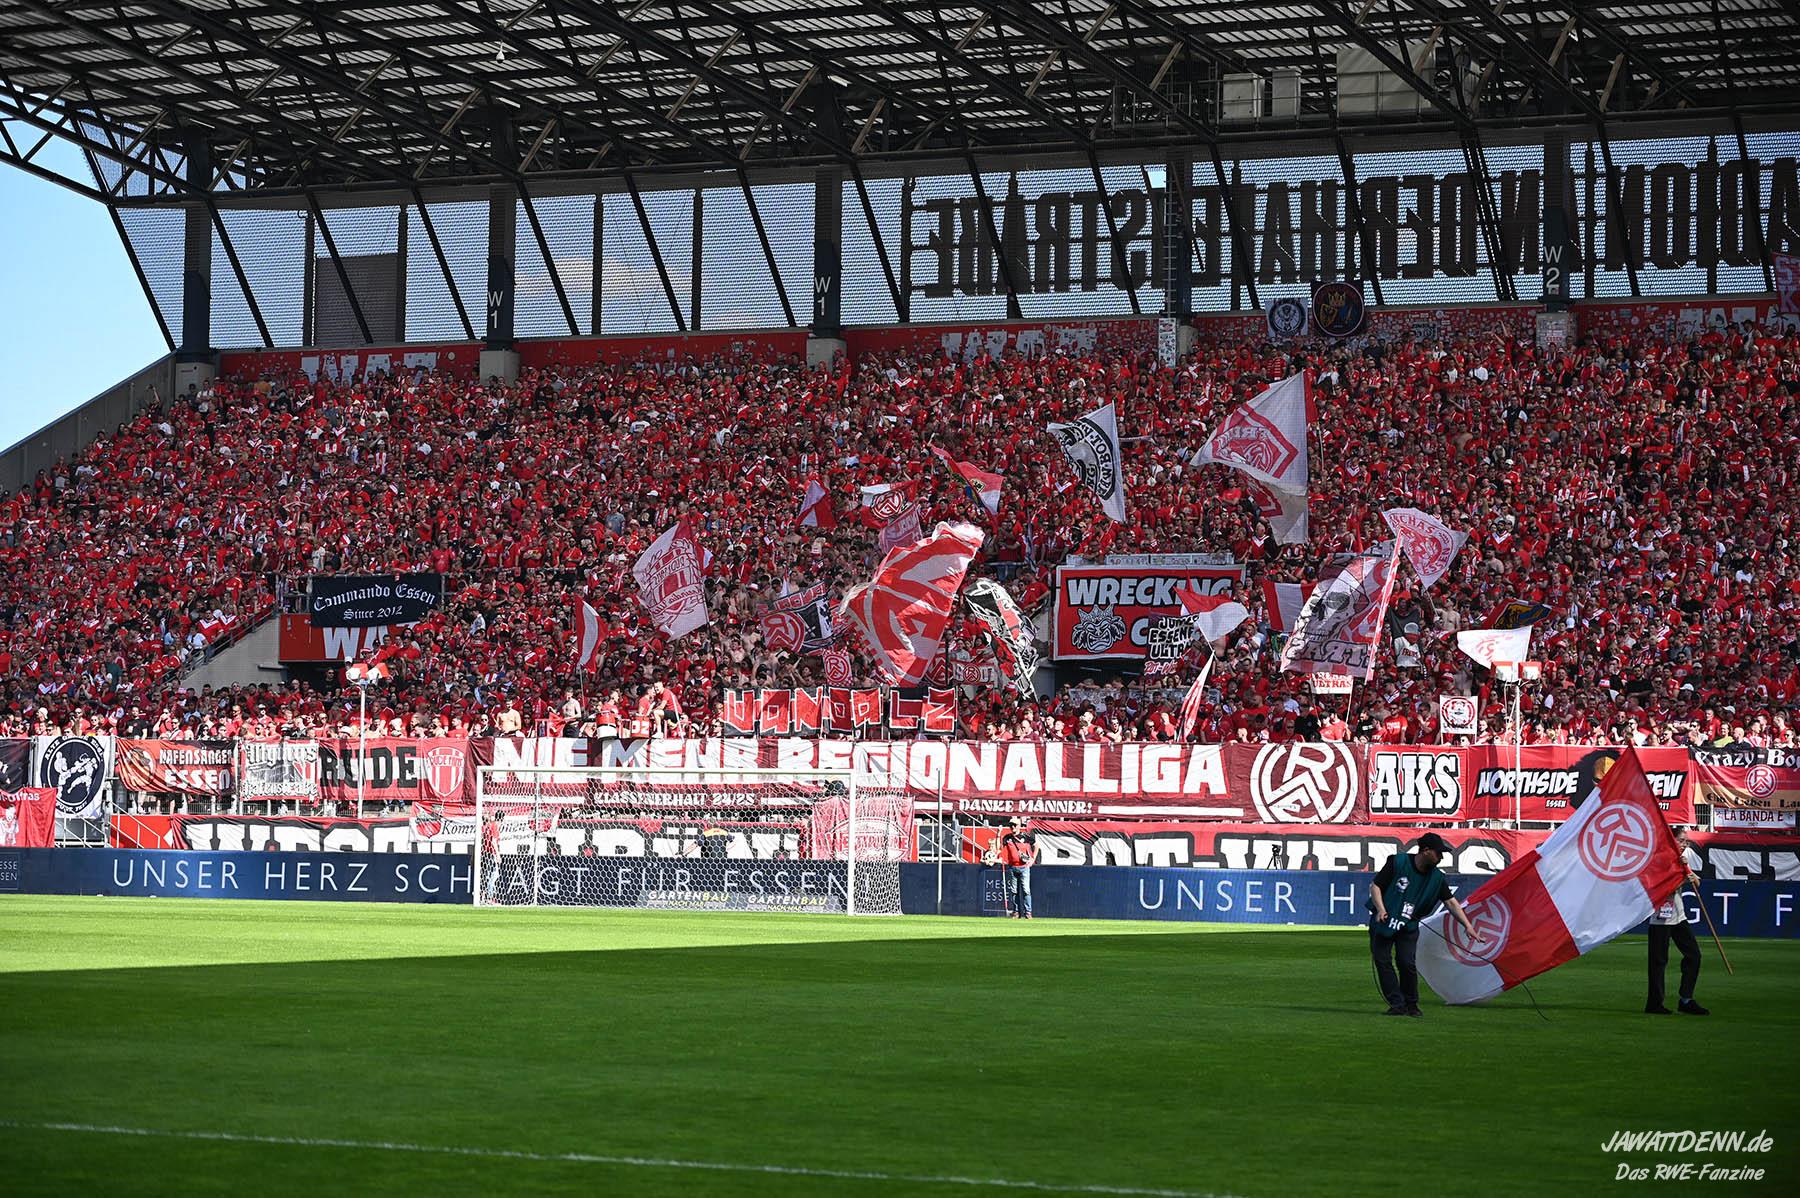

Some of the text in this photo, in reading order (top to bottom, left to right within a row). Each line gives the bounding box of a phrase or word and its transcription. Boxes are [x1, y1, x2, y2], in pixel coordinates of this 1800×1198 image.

[1544, 246, 1562, 264] W
[814, 276, 831, 293] W
[1546, 268, 1560, 288] 2
[488, 291, 503, 307] W
[817, 296, 826, 316] 1
[491, 310, 498, 328] 1
[313, 583, 436, 612] Commando Essen
[343, 605, 403, 620] Since 2012
[318, 745, 418, 789] RUDE
[492, 737, 1228, 795] NIE MEHR REGIONALLIGA
[1371, 752, 1461, 814] AKS
[1477, 771, 1579, 795] NORTHSIDE
[958, 798, 1092, 814] DANKE MÄNNER!
[1545, 799, 1567, 808] ESSEN
[1723, 809, 1737, 821] LA
[1739, 810, 1775, 822] BANDA
[113, 858, 239, 890] UNSER
[265, 861, 370, 892] HERZ
[394, 862, 590, 896] SCHAGT
[648, 890, 730, 902] GARTENBAU
[748, 894, 828, 906] GARTENBAU
[1138, 878, 1298, 914] UNSER
